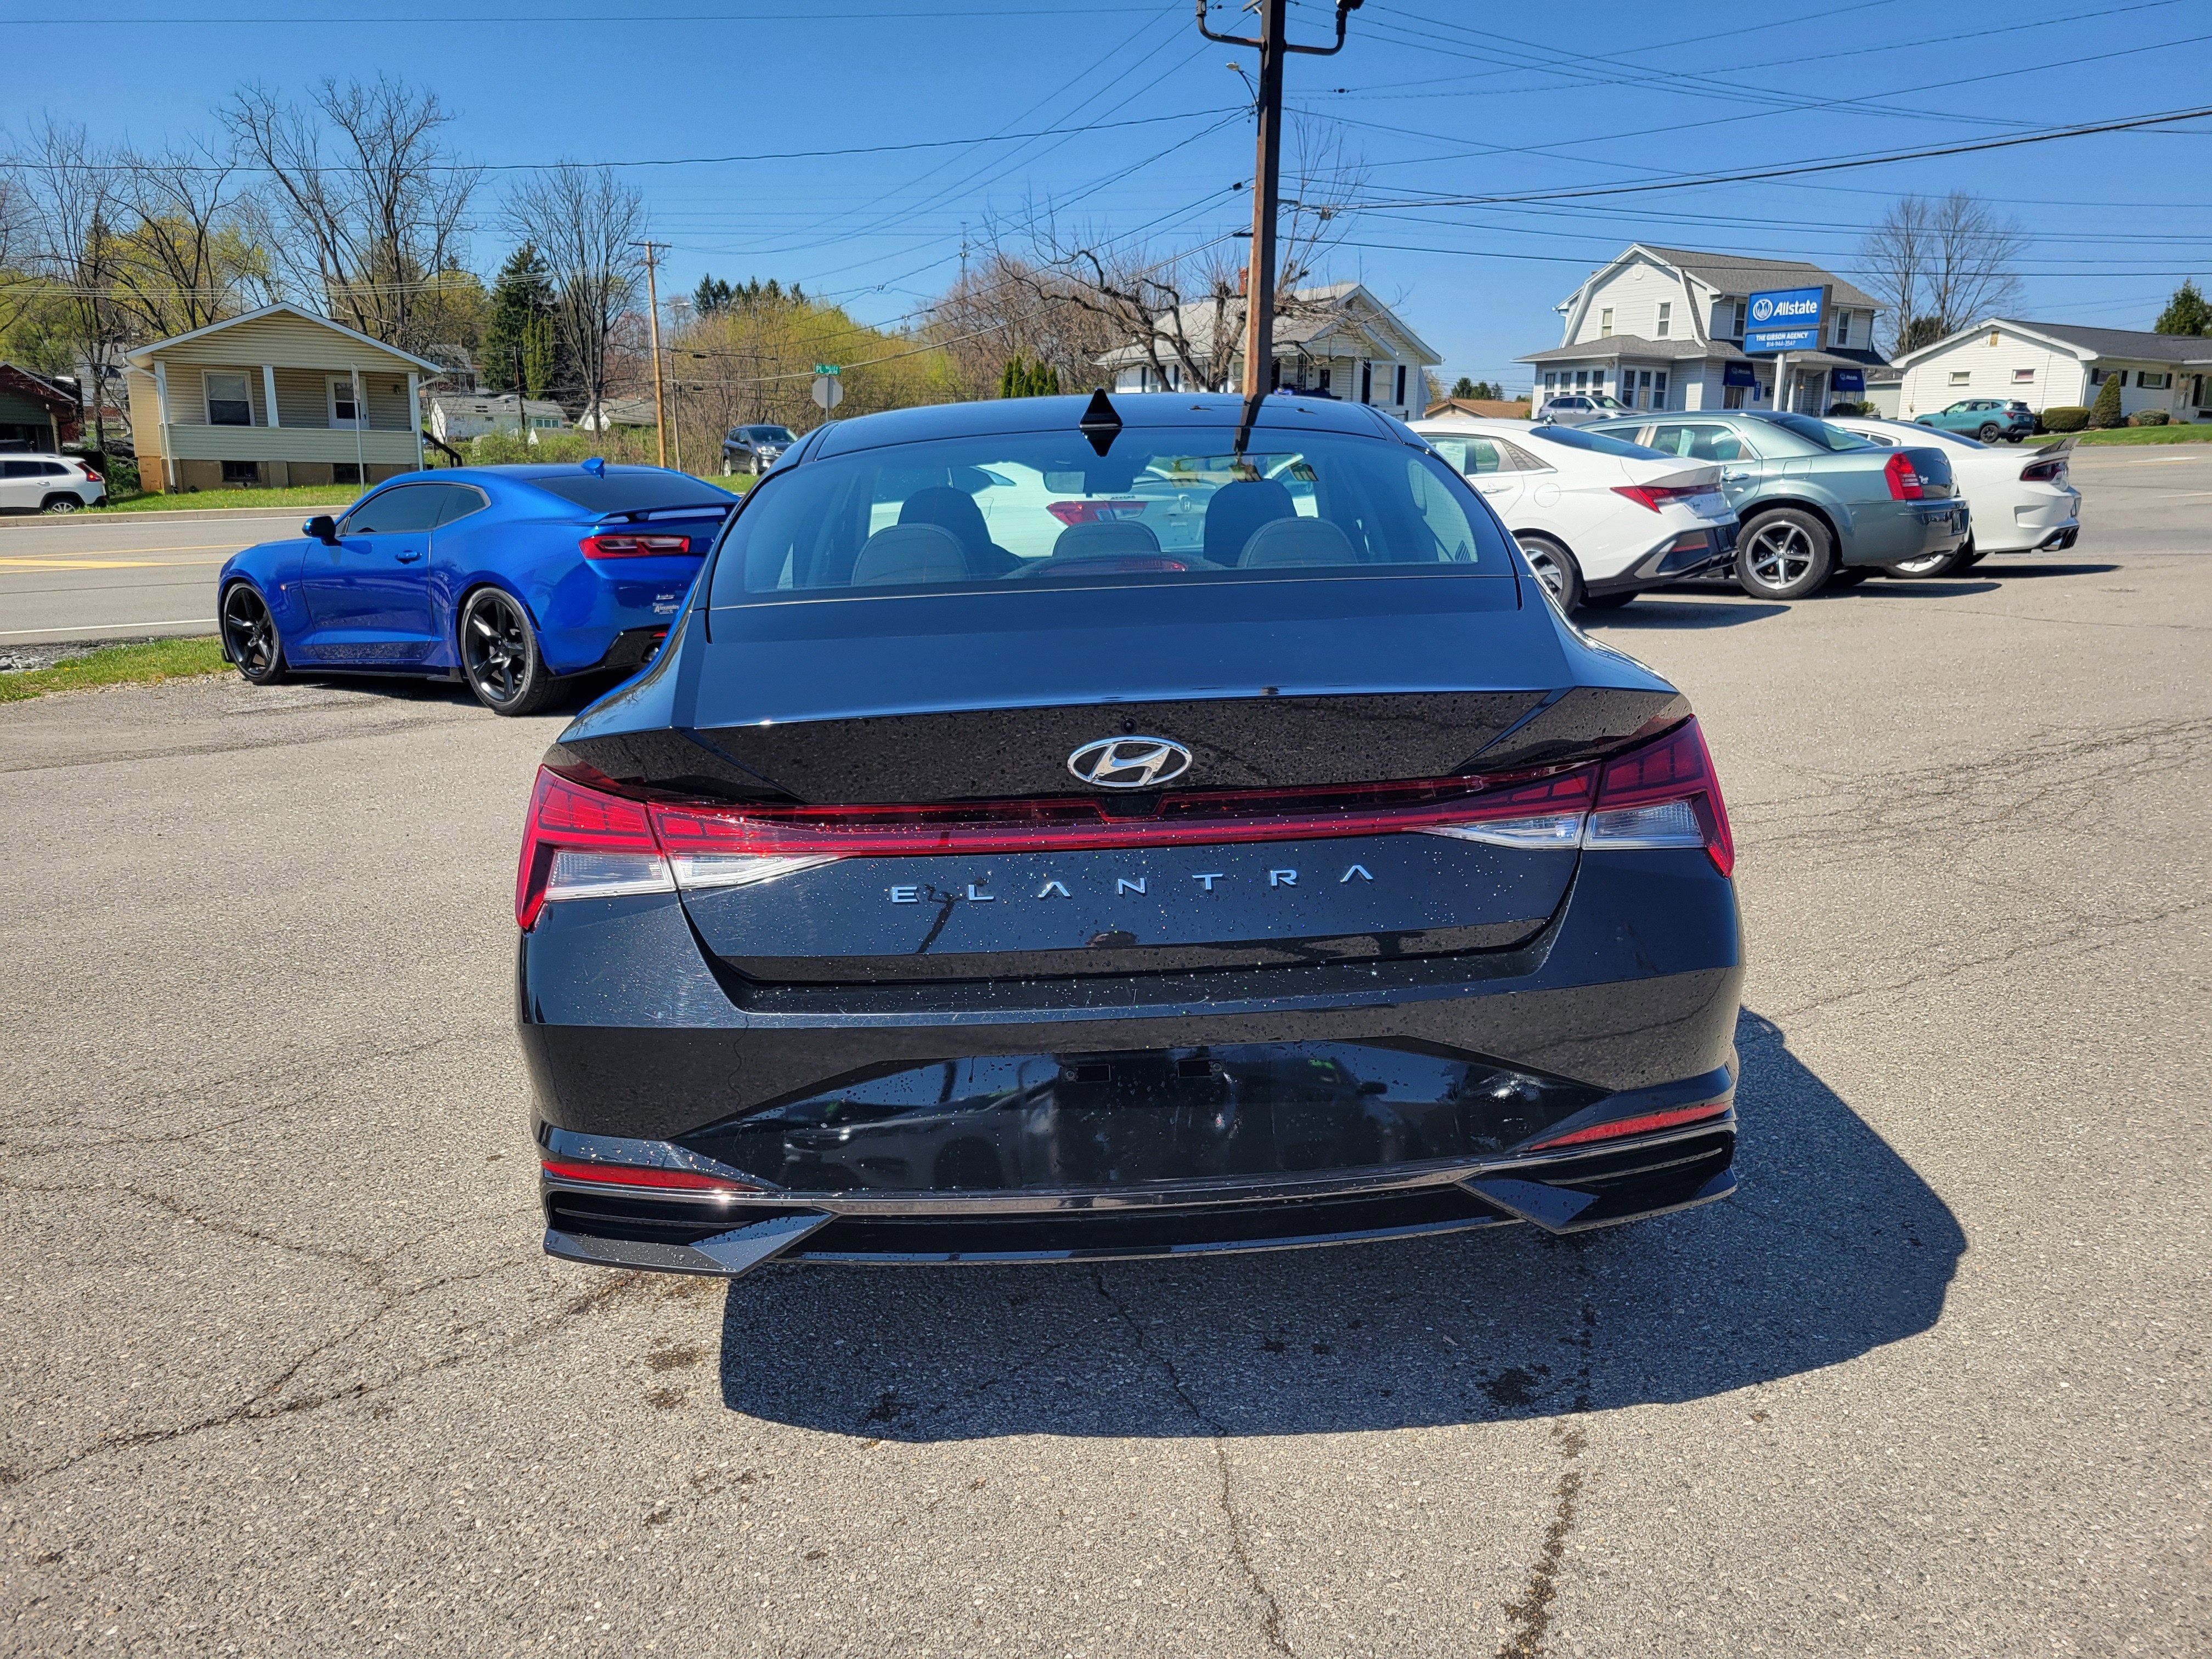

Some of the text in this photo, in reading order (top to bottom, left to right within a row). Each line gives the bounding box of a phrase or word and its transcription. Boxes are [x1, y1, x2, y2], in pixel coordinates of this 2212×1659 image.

[1773, 300, 1817, 316] Allstate
[1767, 332, 1786, 341] GIBSON
[1786, 331, 1809, 339] AGENCY
[891, 864, 1374, 904] ELANTRA
